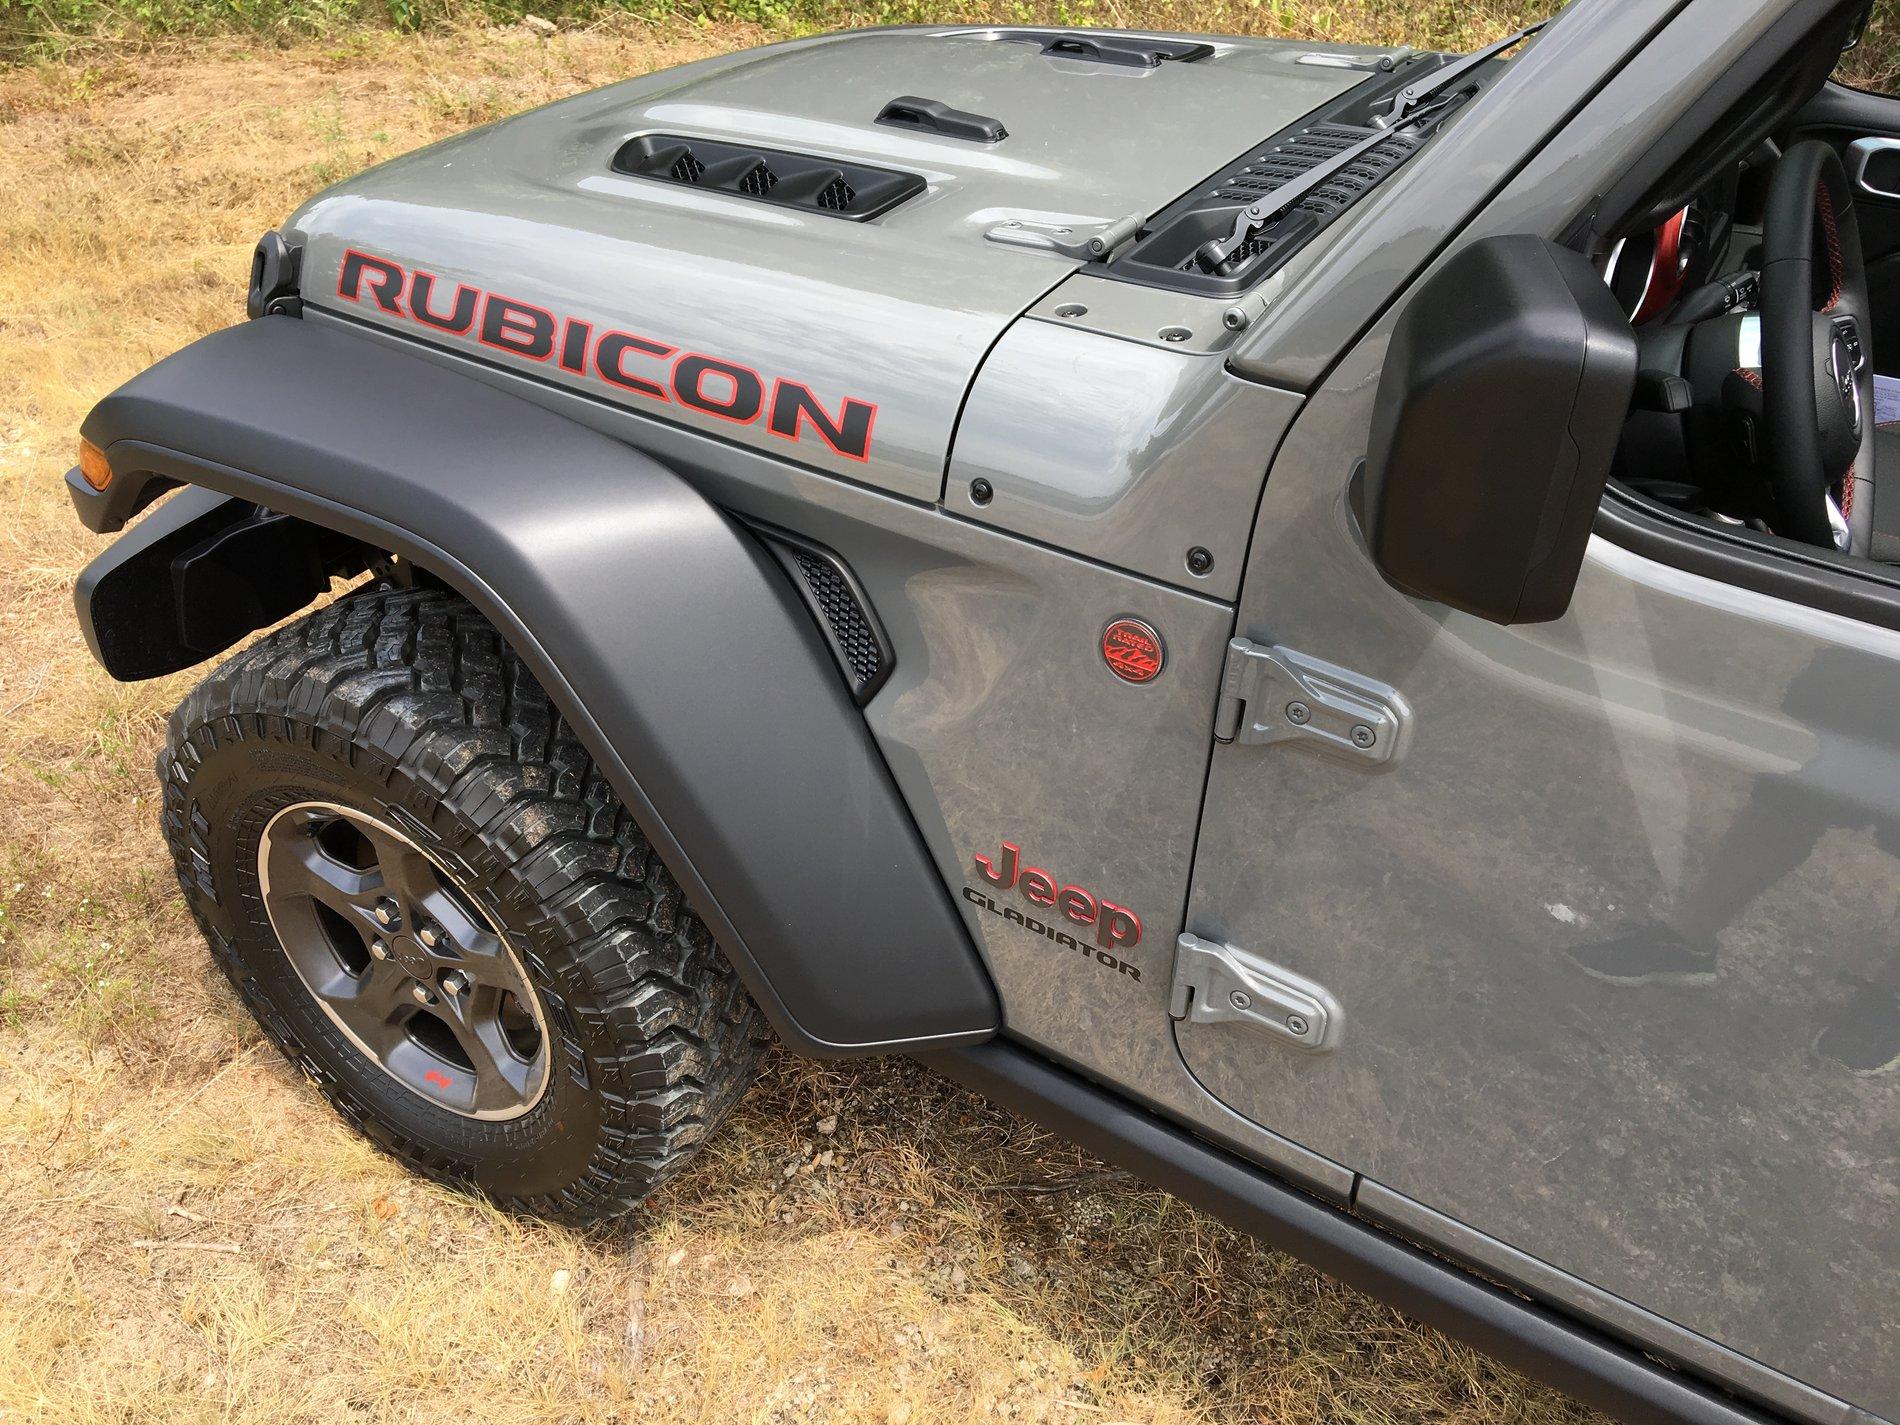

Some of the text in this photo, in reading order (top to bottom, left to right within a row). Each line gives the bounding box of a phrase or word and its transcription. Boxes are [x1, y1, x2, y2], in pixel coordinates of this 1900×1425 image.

[337, 249, 877, 463] RUBICON
[962, 886, 1142, 983] GLADIATOR
[975, 840, 1143, 950] Jeep
